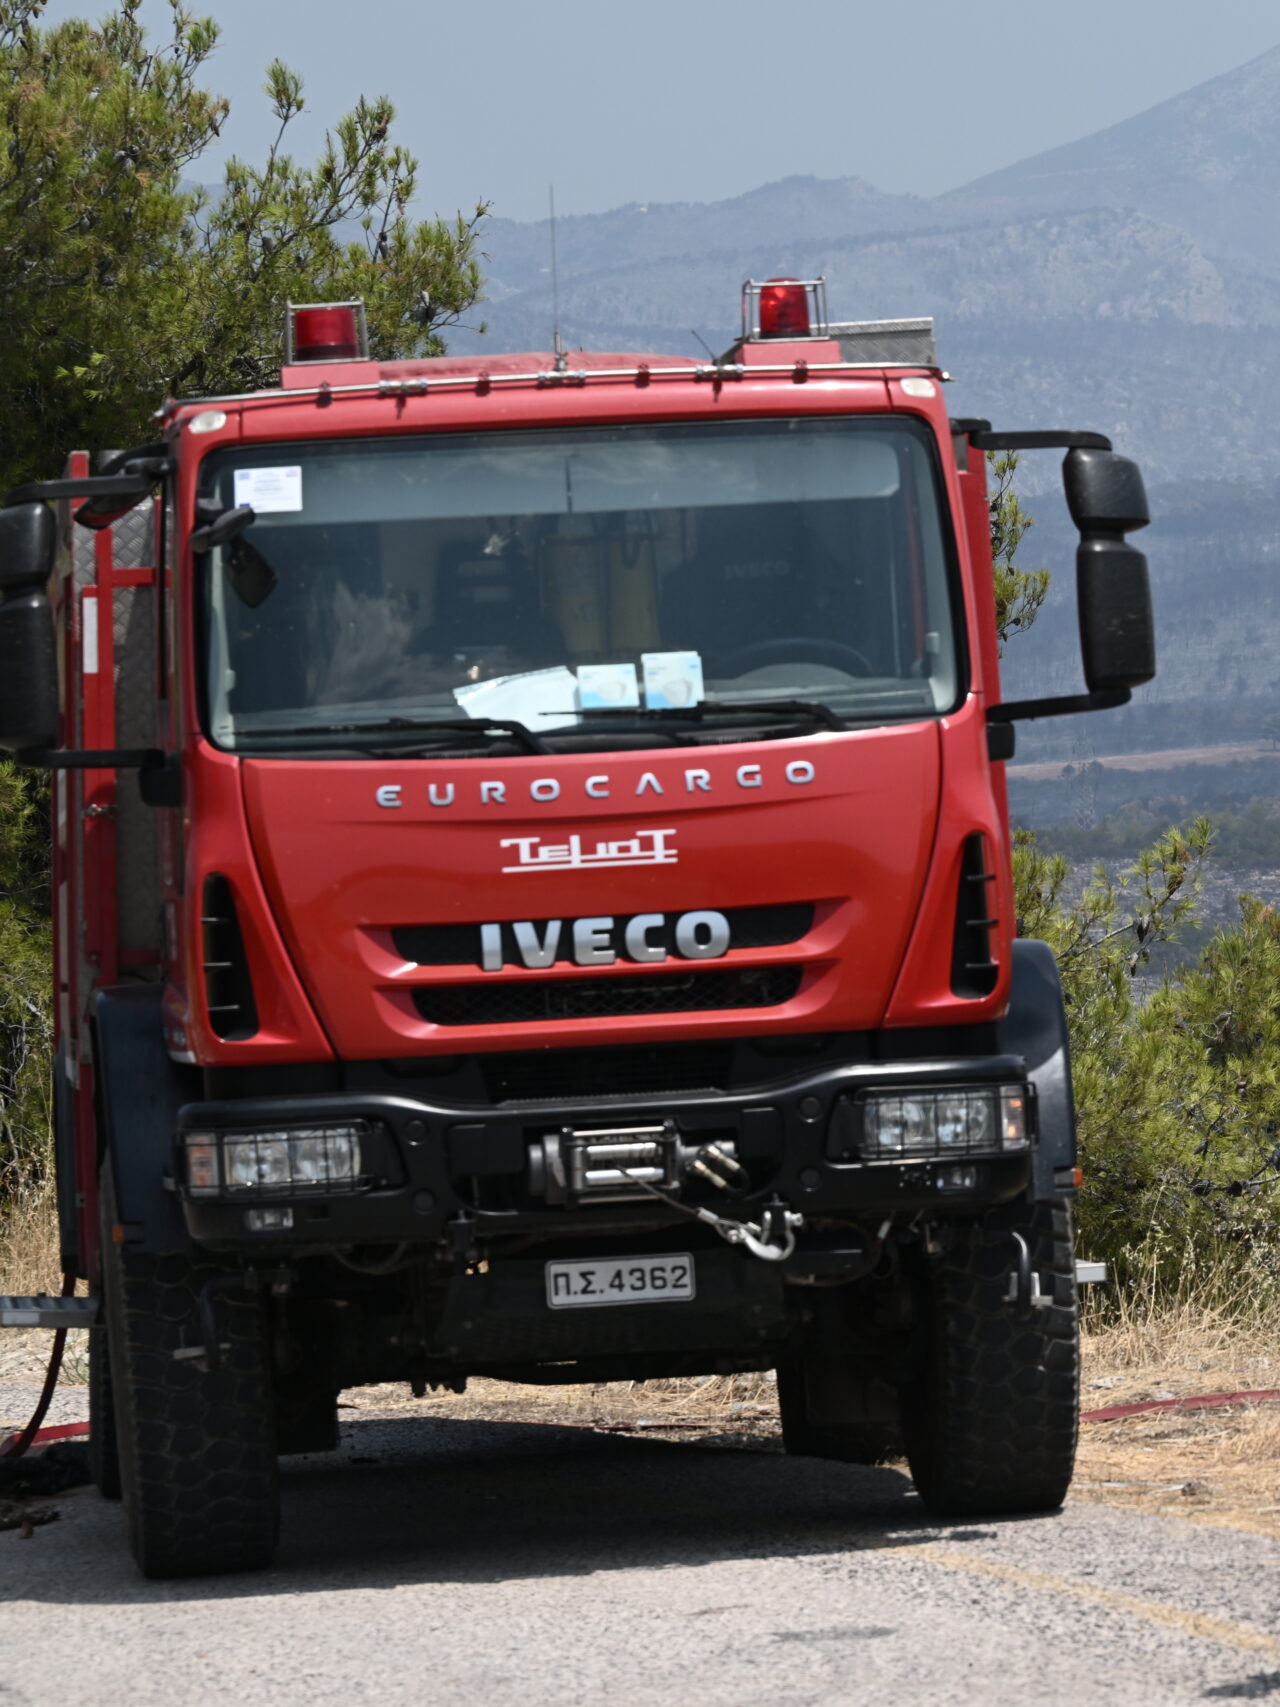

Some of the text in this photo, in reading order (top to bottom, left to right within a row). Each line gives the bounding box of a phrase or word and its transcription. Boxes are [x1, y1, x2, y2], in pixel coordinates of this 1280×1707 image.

[724, 560, 789, 579] IVECO
[376, 760, 815, 807] EUROCARGO
[480, 910, 730, 971] IVECO
[553, 1265, 688, 1296] Π.Σ.4362
